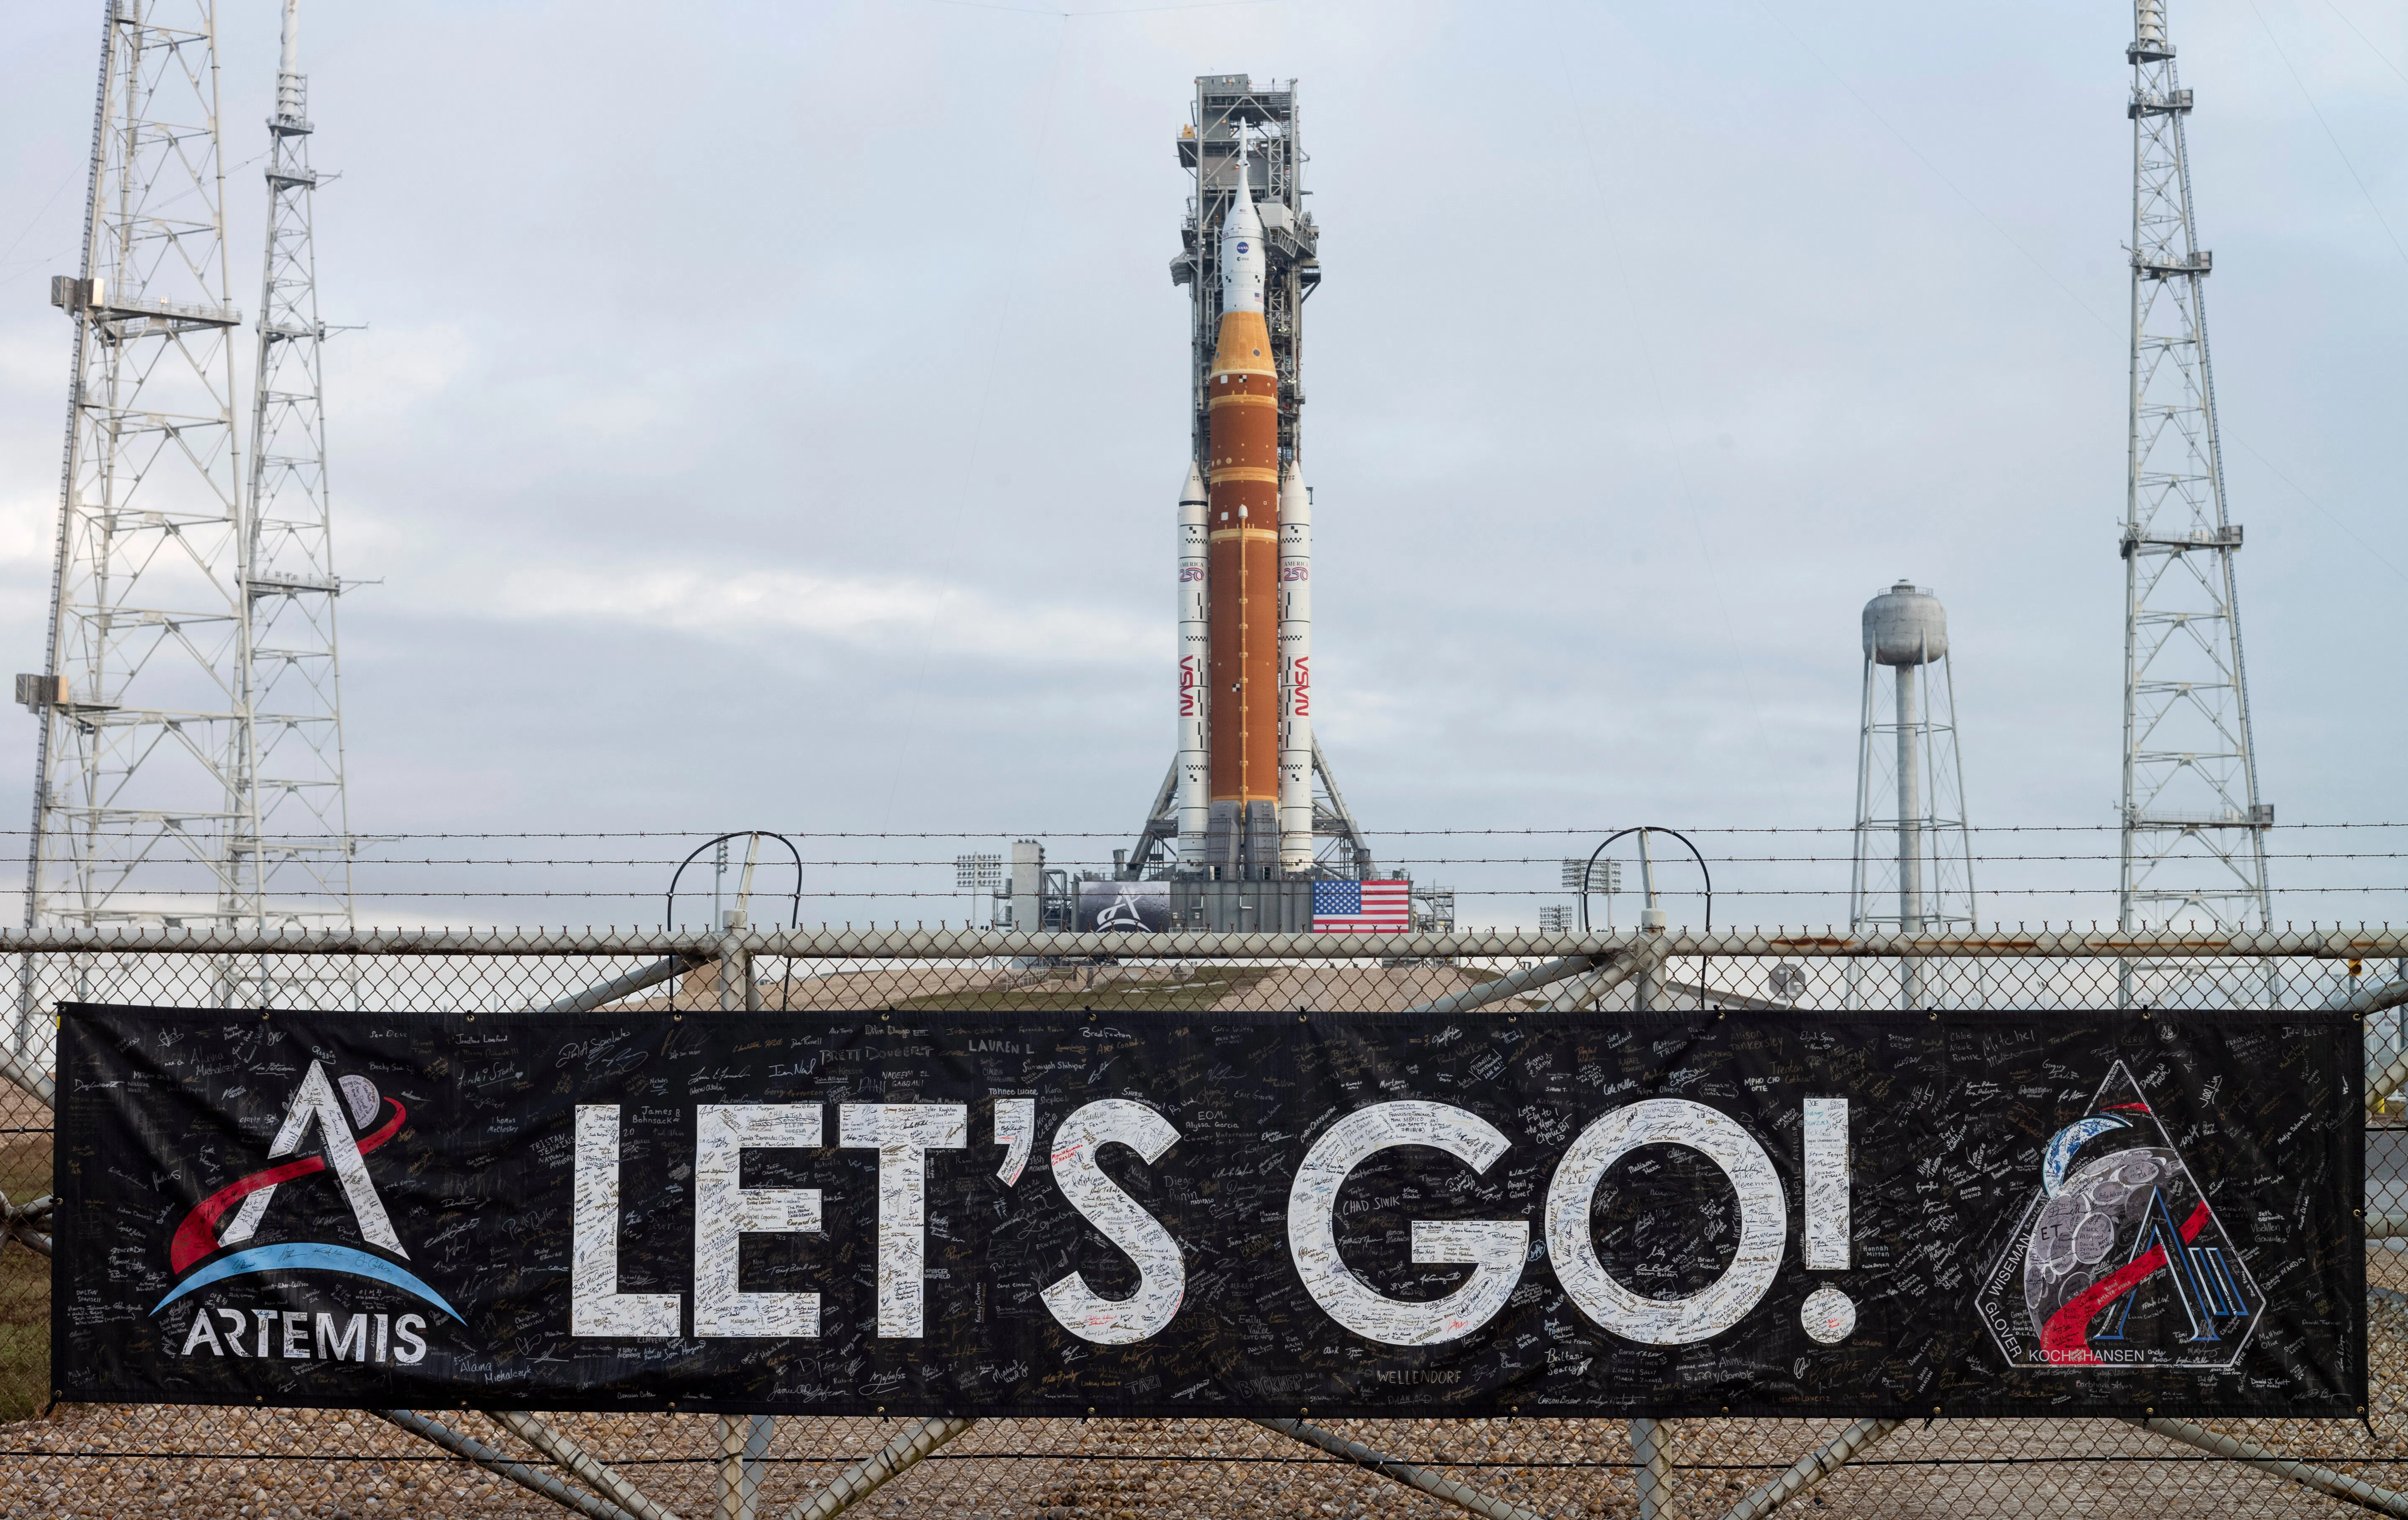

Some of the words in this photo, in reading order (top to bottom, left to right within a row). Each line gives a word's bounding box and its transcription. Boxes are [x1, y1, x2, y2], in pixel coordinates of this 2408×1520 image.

[1284, 566, 1309, 581] 250
[1180, 655, 1194, 716] NASA
[1295, 656, 1309, 716] NASA
[571, 1098, 1186, 1345] LET'S
[1287, 1098, 1856, 1346] GO!
[1989, 1232, 2033, 1297] WISEMAN
[181, 1308, 426, 1363] ARTEMIS
[1985, 1301, 2022, 1358] GLOVER
[2029, 1350, 2071, 1362] KOCH
[2083, 1350, 2144, 1362] HANSEN
